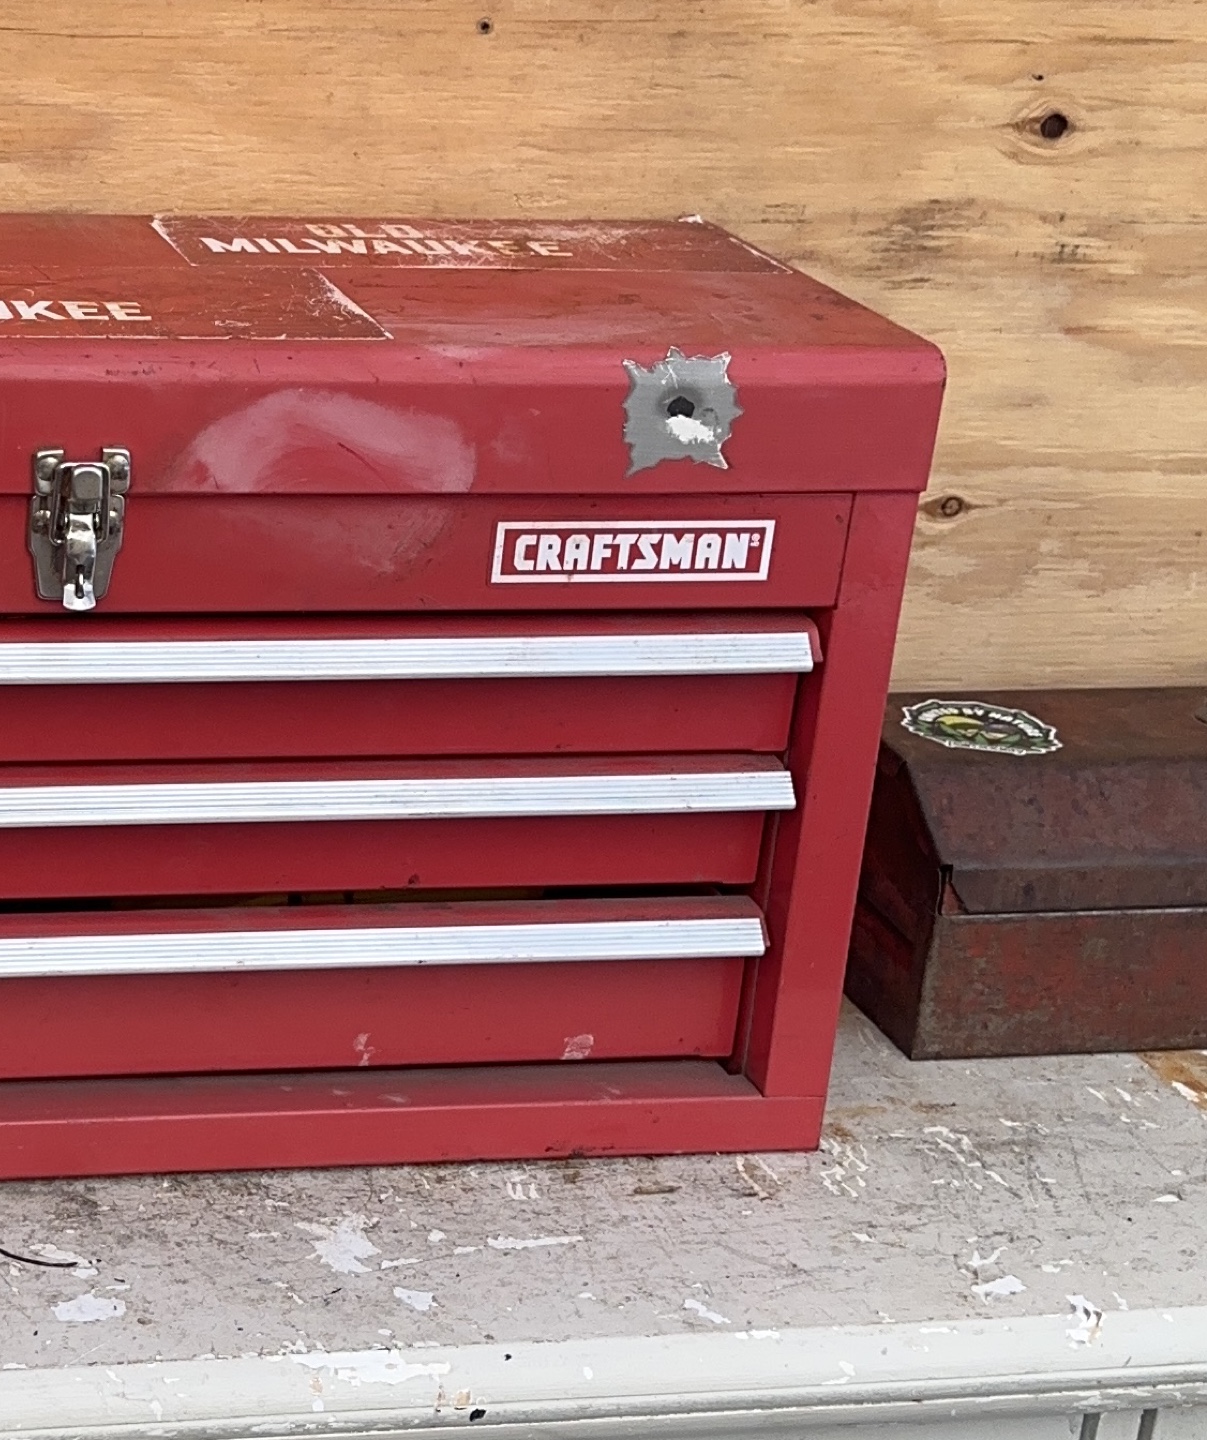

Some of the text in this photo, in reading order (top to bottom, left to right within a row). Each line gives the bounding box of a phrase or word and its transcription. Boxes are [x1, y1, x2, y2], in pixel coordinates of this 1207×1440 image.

[305, 223, 425, 239] OLD
[199, 237, 573, 257] MILWAUKEE
[513, 532, 751, 571] CRAFTSMAN
